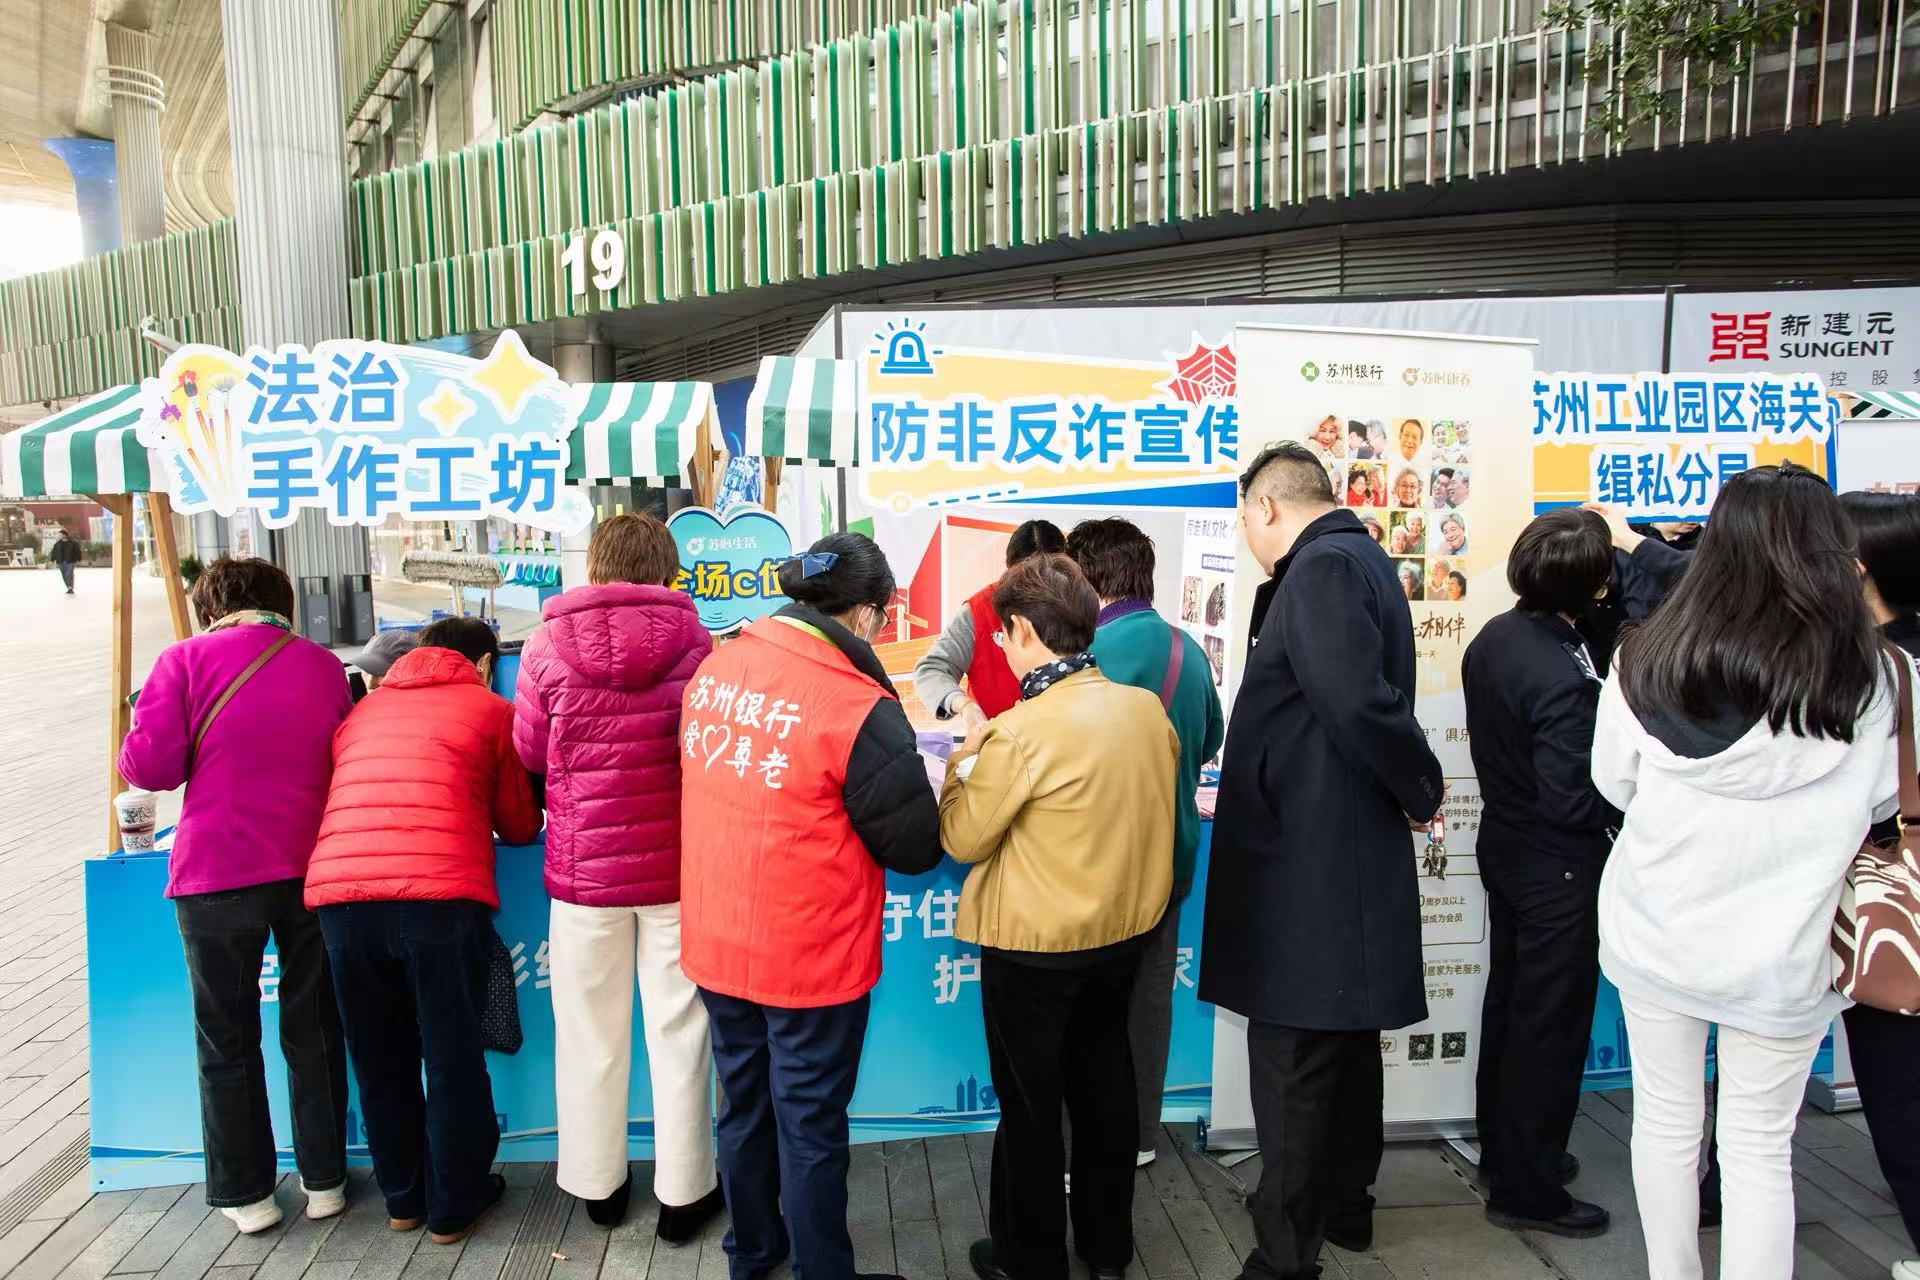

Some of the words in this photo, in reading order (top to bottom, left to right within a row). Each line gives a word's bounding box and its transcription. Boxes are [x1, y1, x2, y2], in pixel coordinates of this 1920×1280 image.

[561, 229, 624, 294] 19
[1781, 311, 1895, 338] 新建元
[1326, 362, 1384, 380] 苏州银行
[1779, 340, 1894, 359] SUNGENT
[246, 351, 399, 424] 法治
[872, 401, 1238, 465] 防非反诈宣传
[248, 441, 561, 519] 手作工坊
[688, 675, 801, 739] 苏州银行
[1423, 962, 1481, 976] 居家为老服务
[1425, 988, 1454, 999] 学习等
